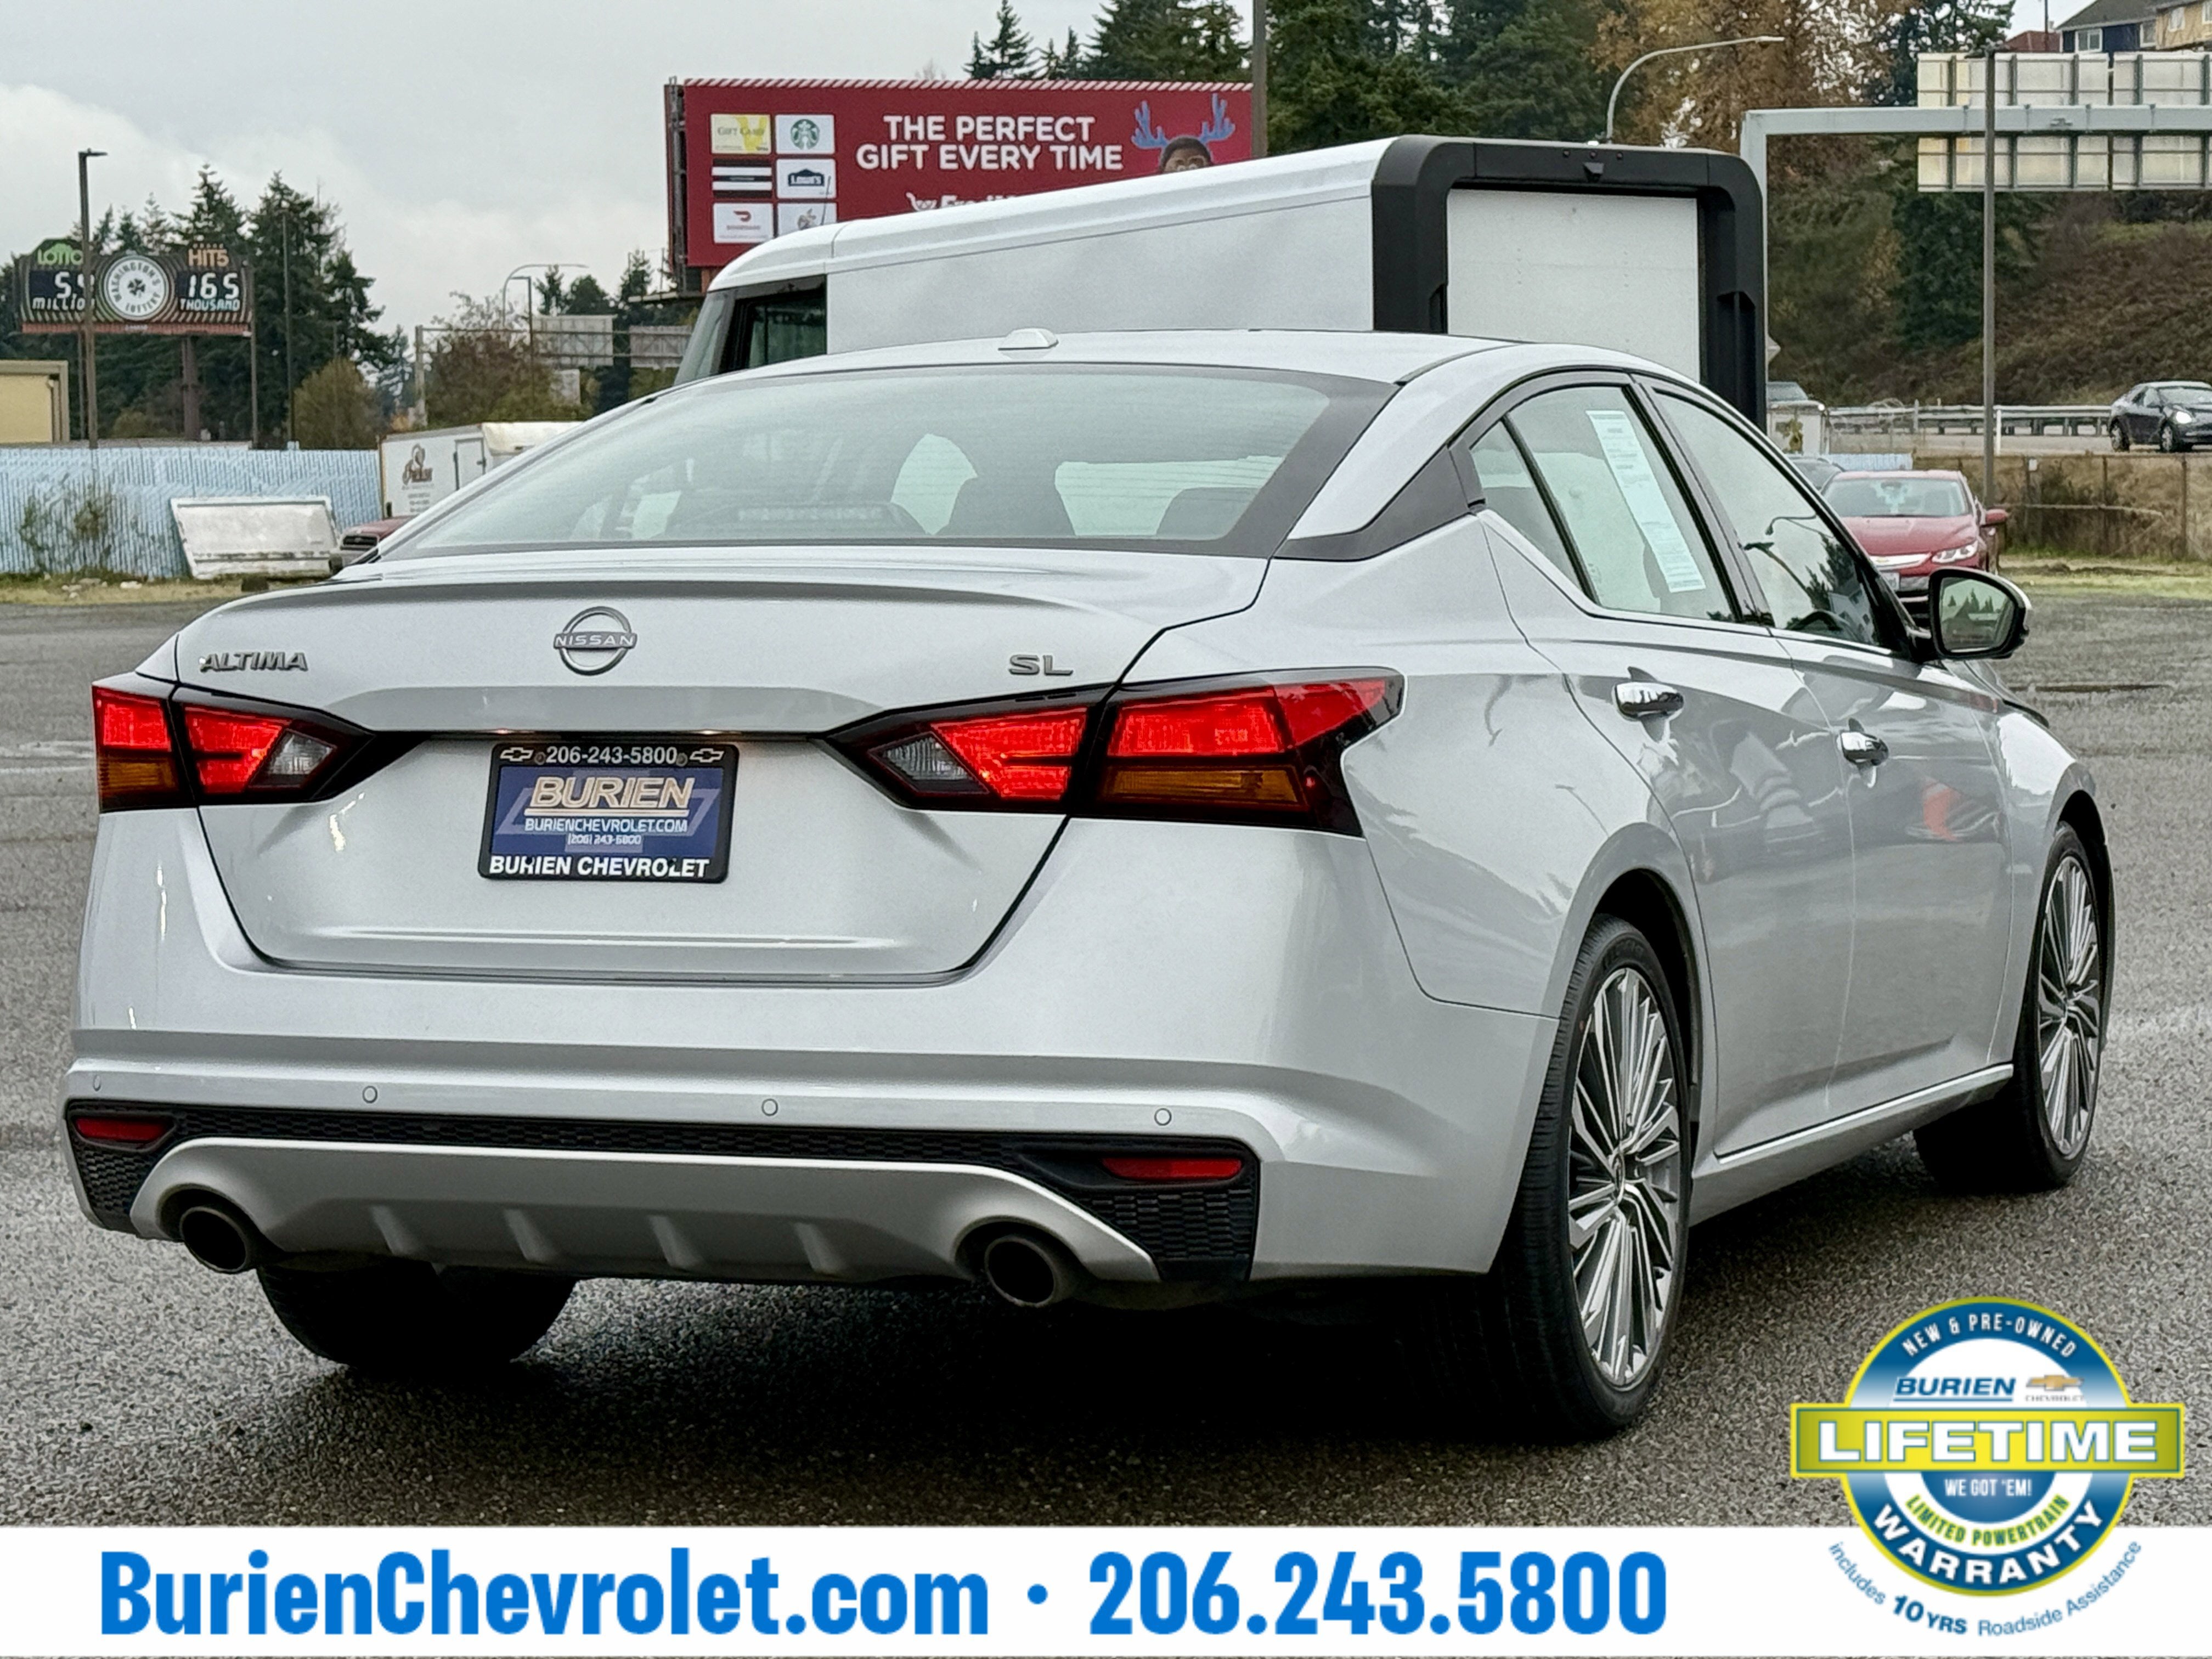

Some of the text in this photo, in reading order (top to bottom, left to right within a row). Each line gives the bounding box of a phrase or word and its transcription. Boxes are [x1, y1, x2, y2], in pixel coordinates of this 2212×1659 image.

[883, 115, 1095, 142] THE PERFECT
[856, 144, 1124, 171] GIFT EVERY TIME
[189, 273, 239, 299] 165
[180, 298, 240, 312] THOUSAND
[555, 635, 634, 646] NISSAN
[200, 651, 308, 673] ALTIMA
[1008, 654, 1074, 676] SL
[545, 746, 678, 764] 206-243-5800
[530, 776, 695, 809] BURIEN
[524, 818, 688, 833] BURIENCHEVROLET.COM
[577, 857, 710, 878] CHEVROLET
